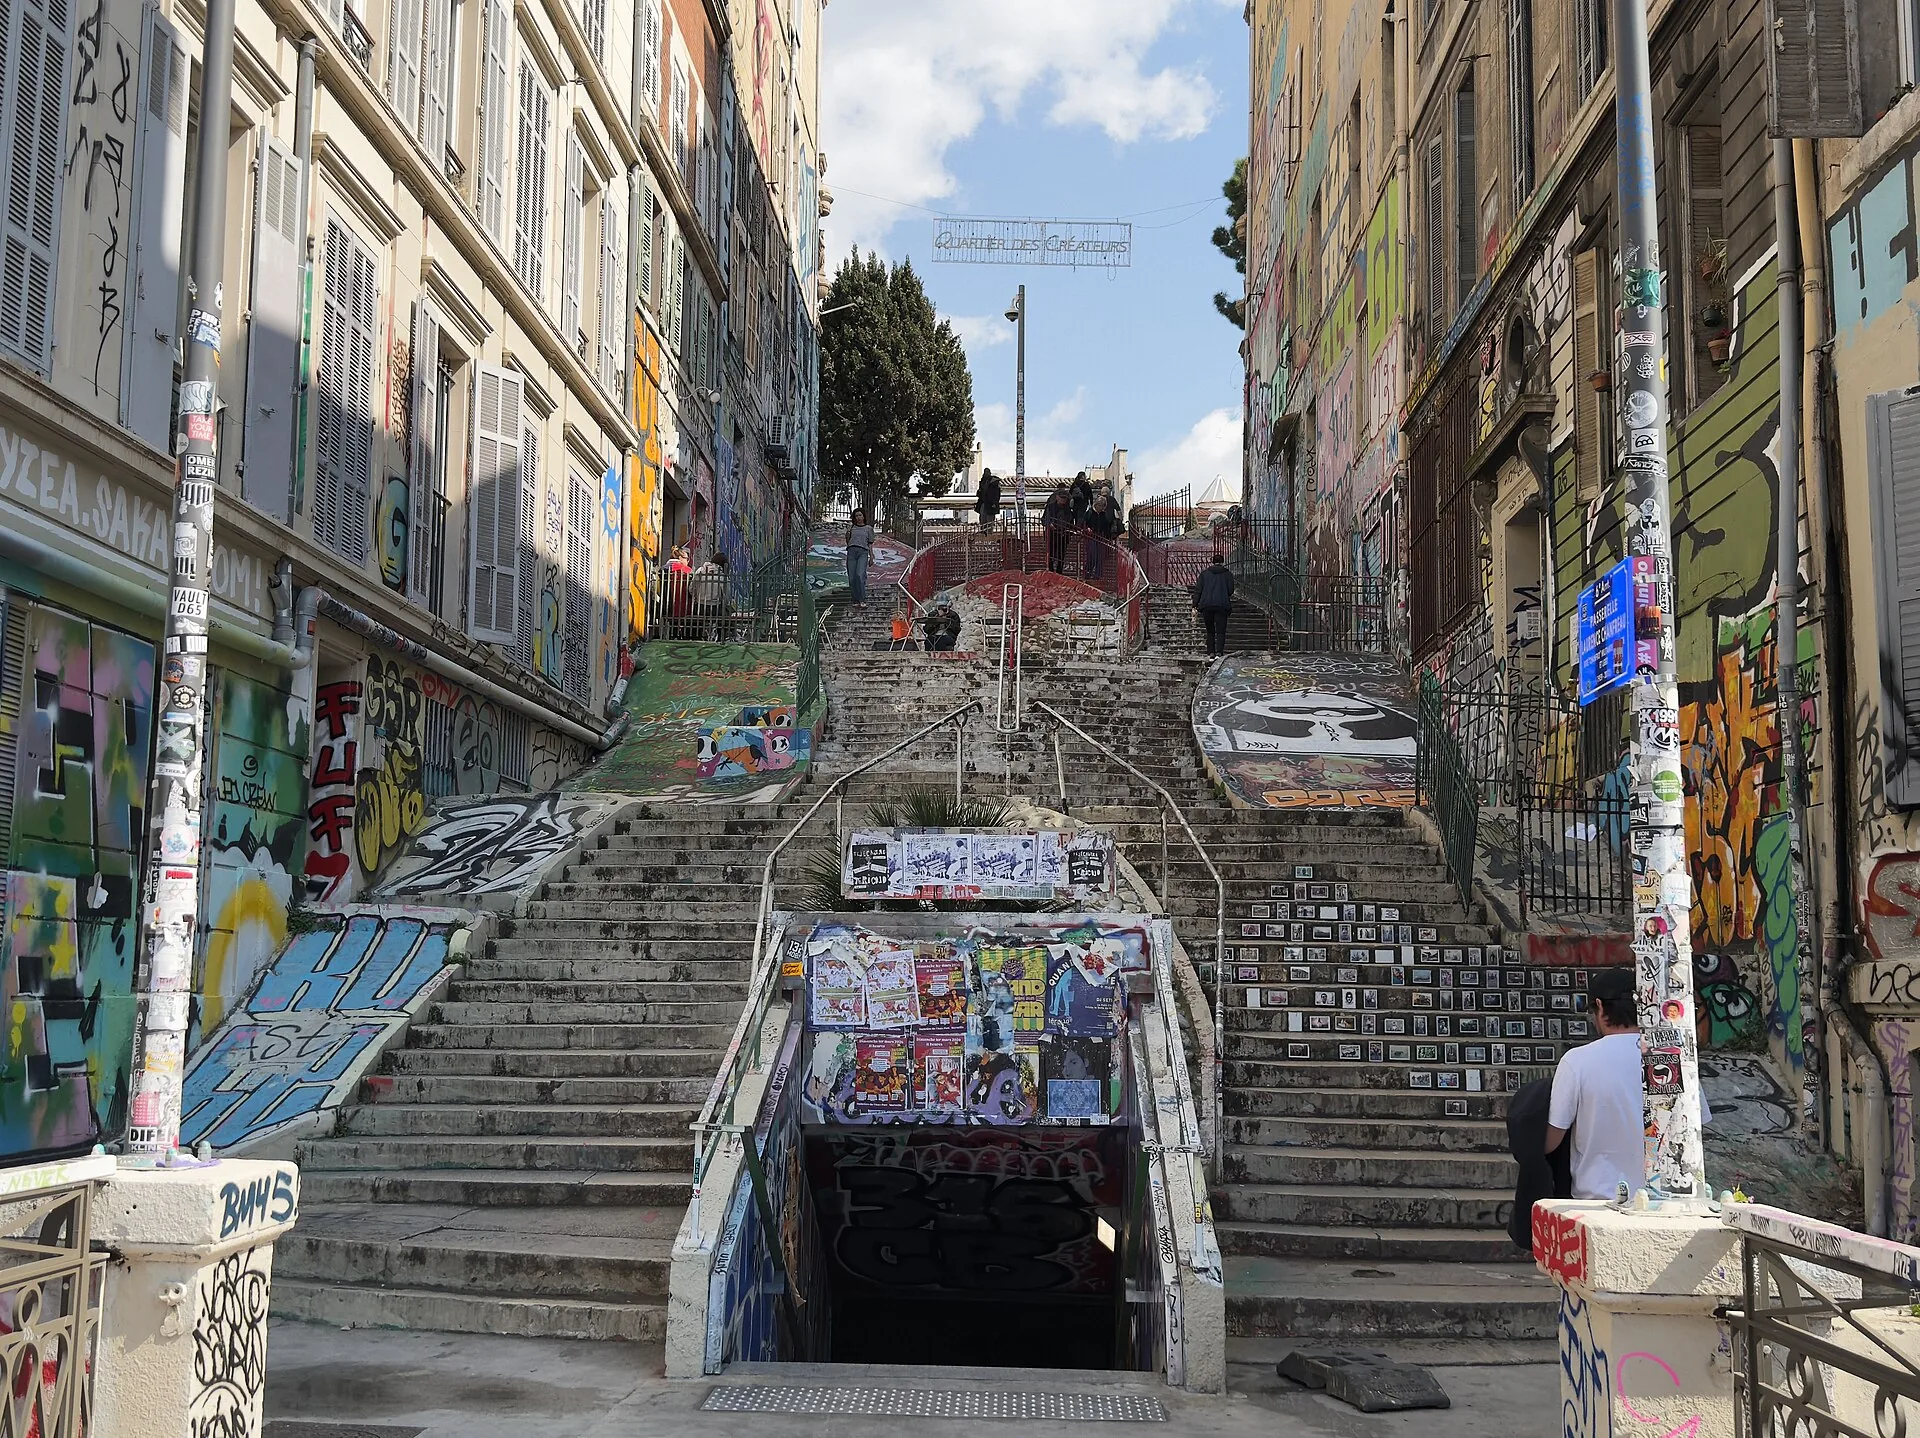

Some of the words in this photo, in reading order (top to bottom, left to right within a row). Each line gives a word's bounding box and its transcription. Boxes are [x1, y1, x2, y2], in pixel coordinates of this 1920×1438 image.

[935, 231, 1005, 250] QUARTIER
[1011, 239, 1040, 251] DES
[1045, 235, 1128, 253] CRÉATEURS
[192, 415, 212, 425] TAKE
[191, 423, 213, 433] YOUR
[192, 431, 211, 440] TIME
[174, 589, 207, 605] VAULT
[177, 602, 202, 616] D65
[1589, 598, 1619, 629] PASSERELLE
[1648, 1083, 1684, 1095] ANTIFA
